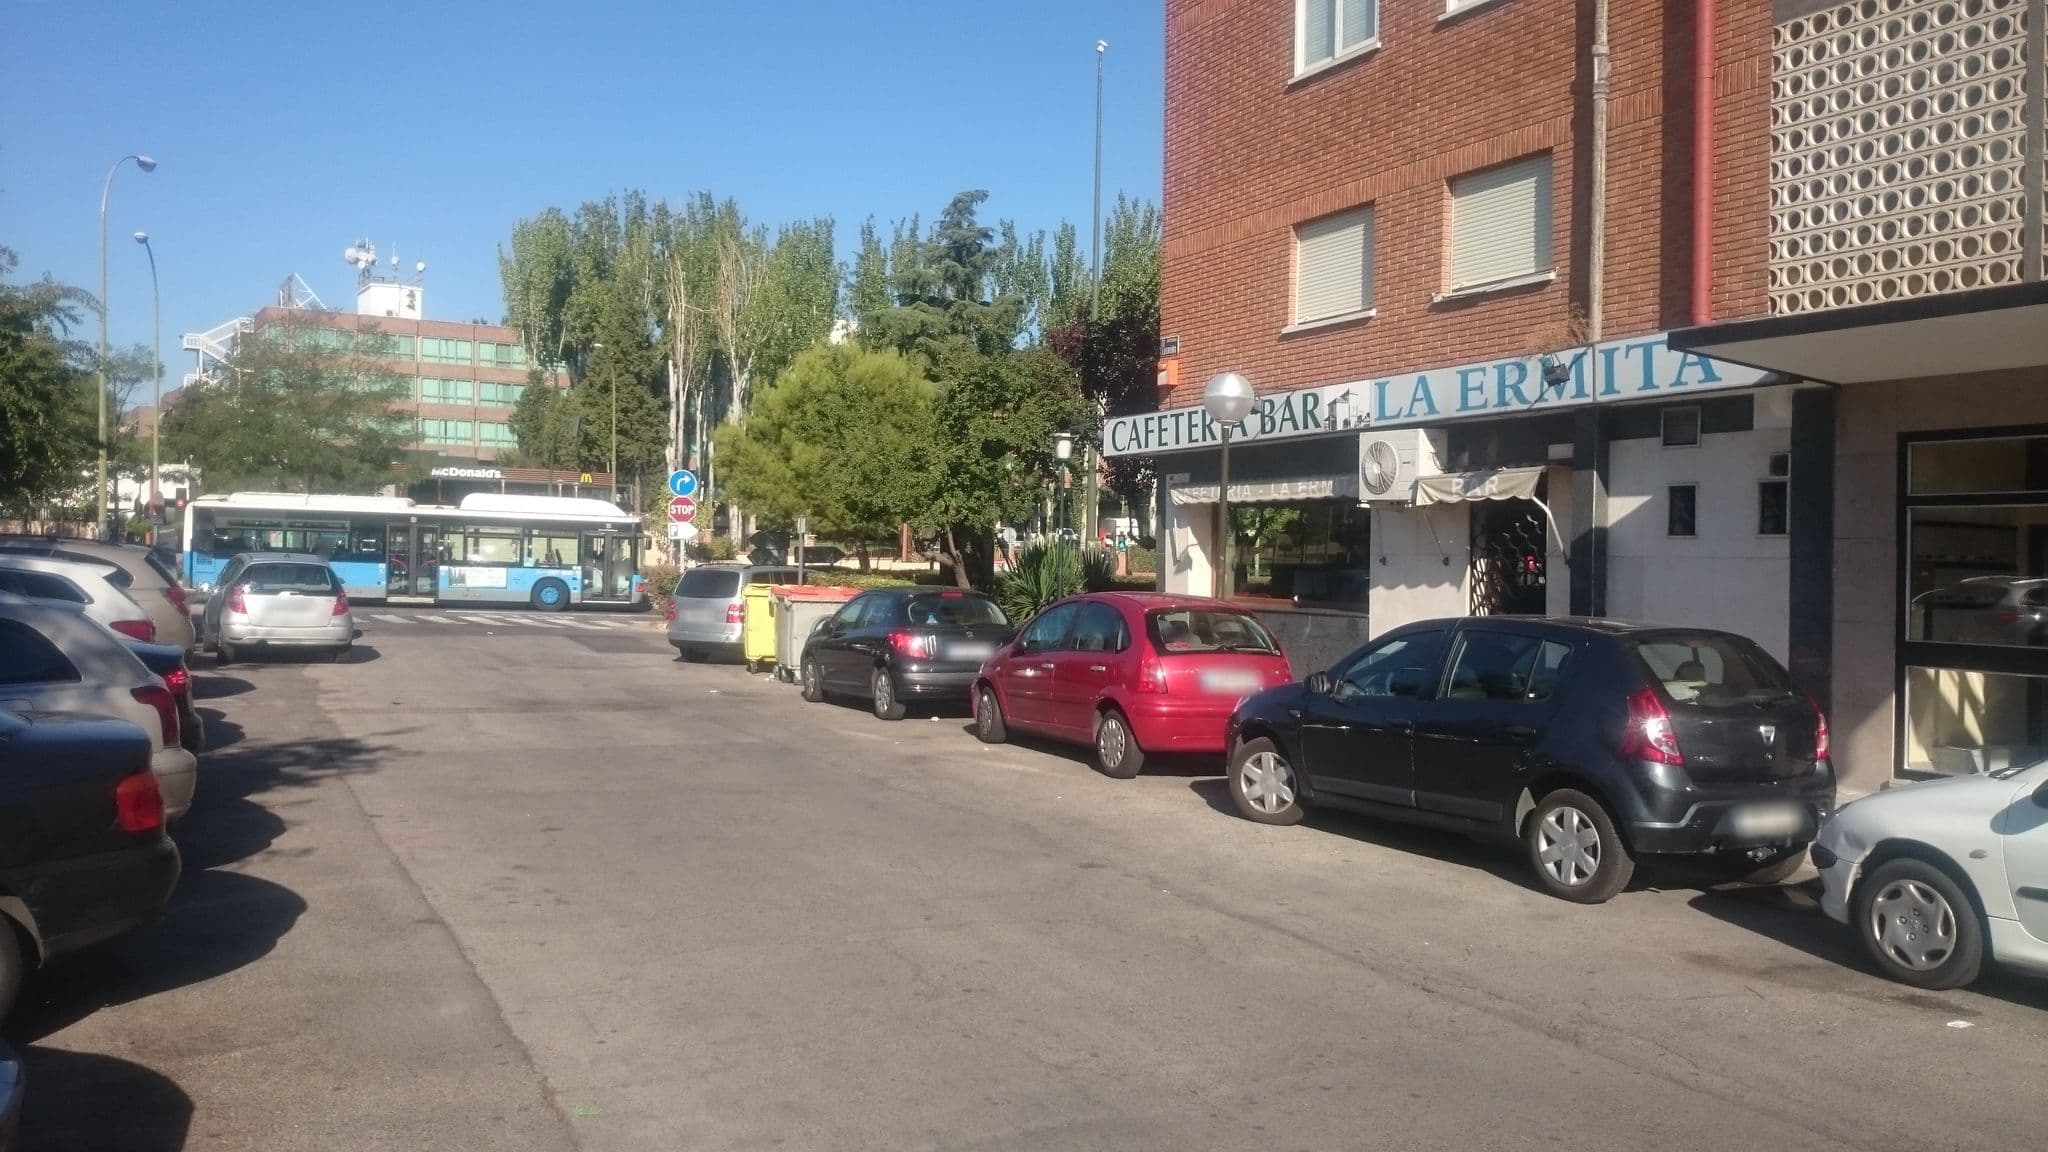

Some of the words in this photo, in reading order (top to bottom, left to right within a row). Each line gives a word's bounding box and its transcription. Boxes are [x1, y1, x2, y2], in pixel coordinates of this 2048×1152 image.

[1374, 374, 1441, 422] LA
[1456, 339, 1723, 412] ERMITA
[1111, 407, 1248, 452] CAFETERA
[1271, 482, 1290, 497] LA
[671, 505, 695, 515] STOP
[670, 526, 678, 536] P
